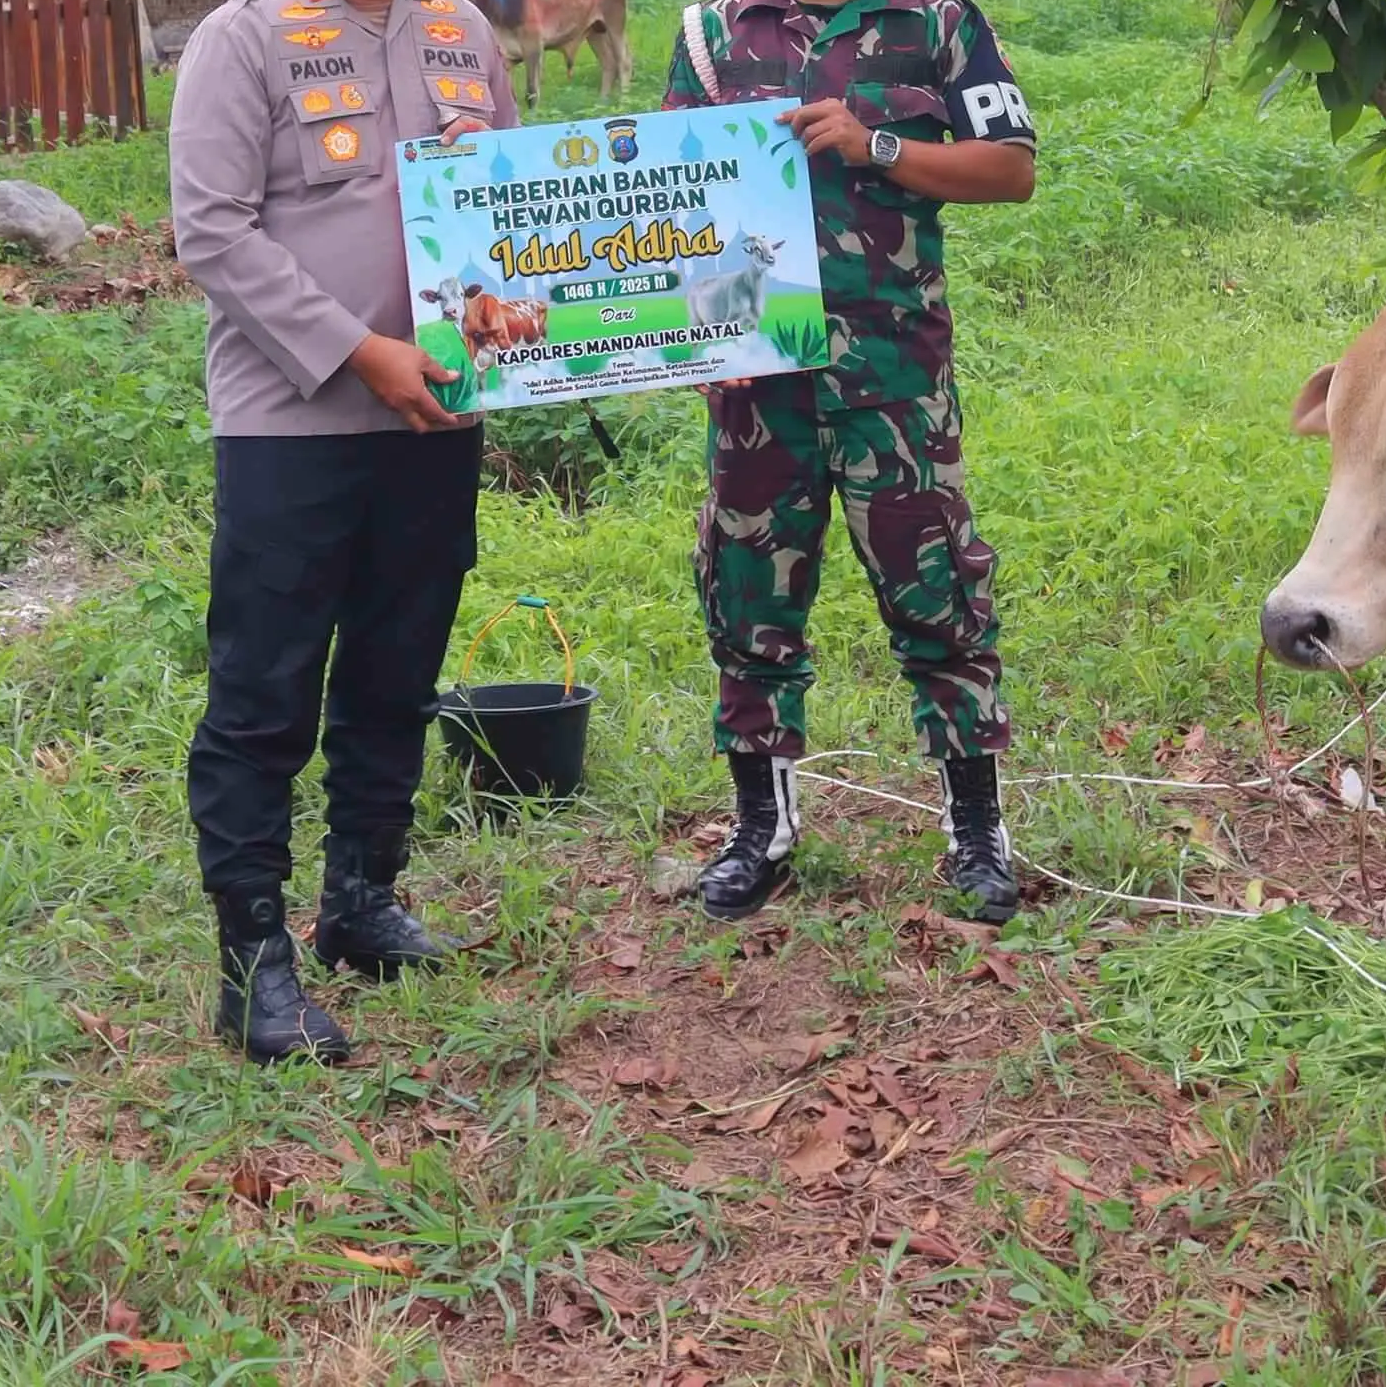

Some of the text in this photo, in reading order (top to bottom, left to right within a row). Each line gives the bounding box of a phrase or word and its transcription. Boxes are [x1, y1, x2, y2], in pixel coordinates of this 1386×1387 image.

[290, 56, 356, 80] PALOH
[423, 48, 480, 70] POLRI
[961, 81, 1031, 138] PR
[453, 159, 739, 210] PEMBERIAN BANTUAN
[492, 188, 707, 231] HEWAN QURBAN
[489, 218, 725, 281] Idul Adha
[562, 275, 667, 301] 1446 H / 2025 M
[601, 307, 635, 323] Dari
[497, 323, 744, 366] KAPOLRES MANDAILING NATAL
